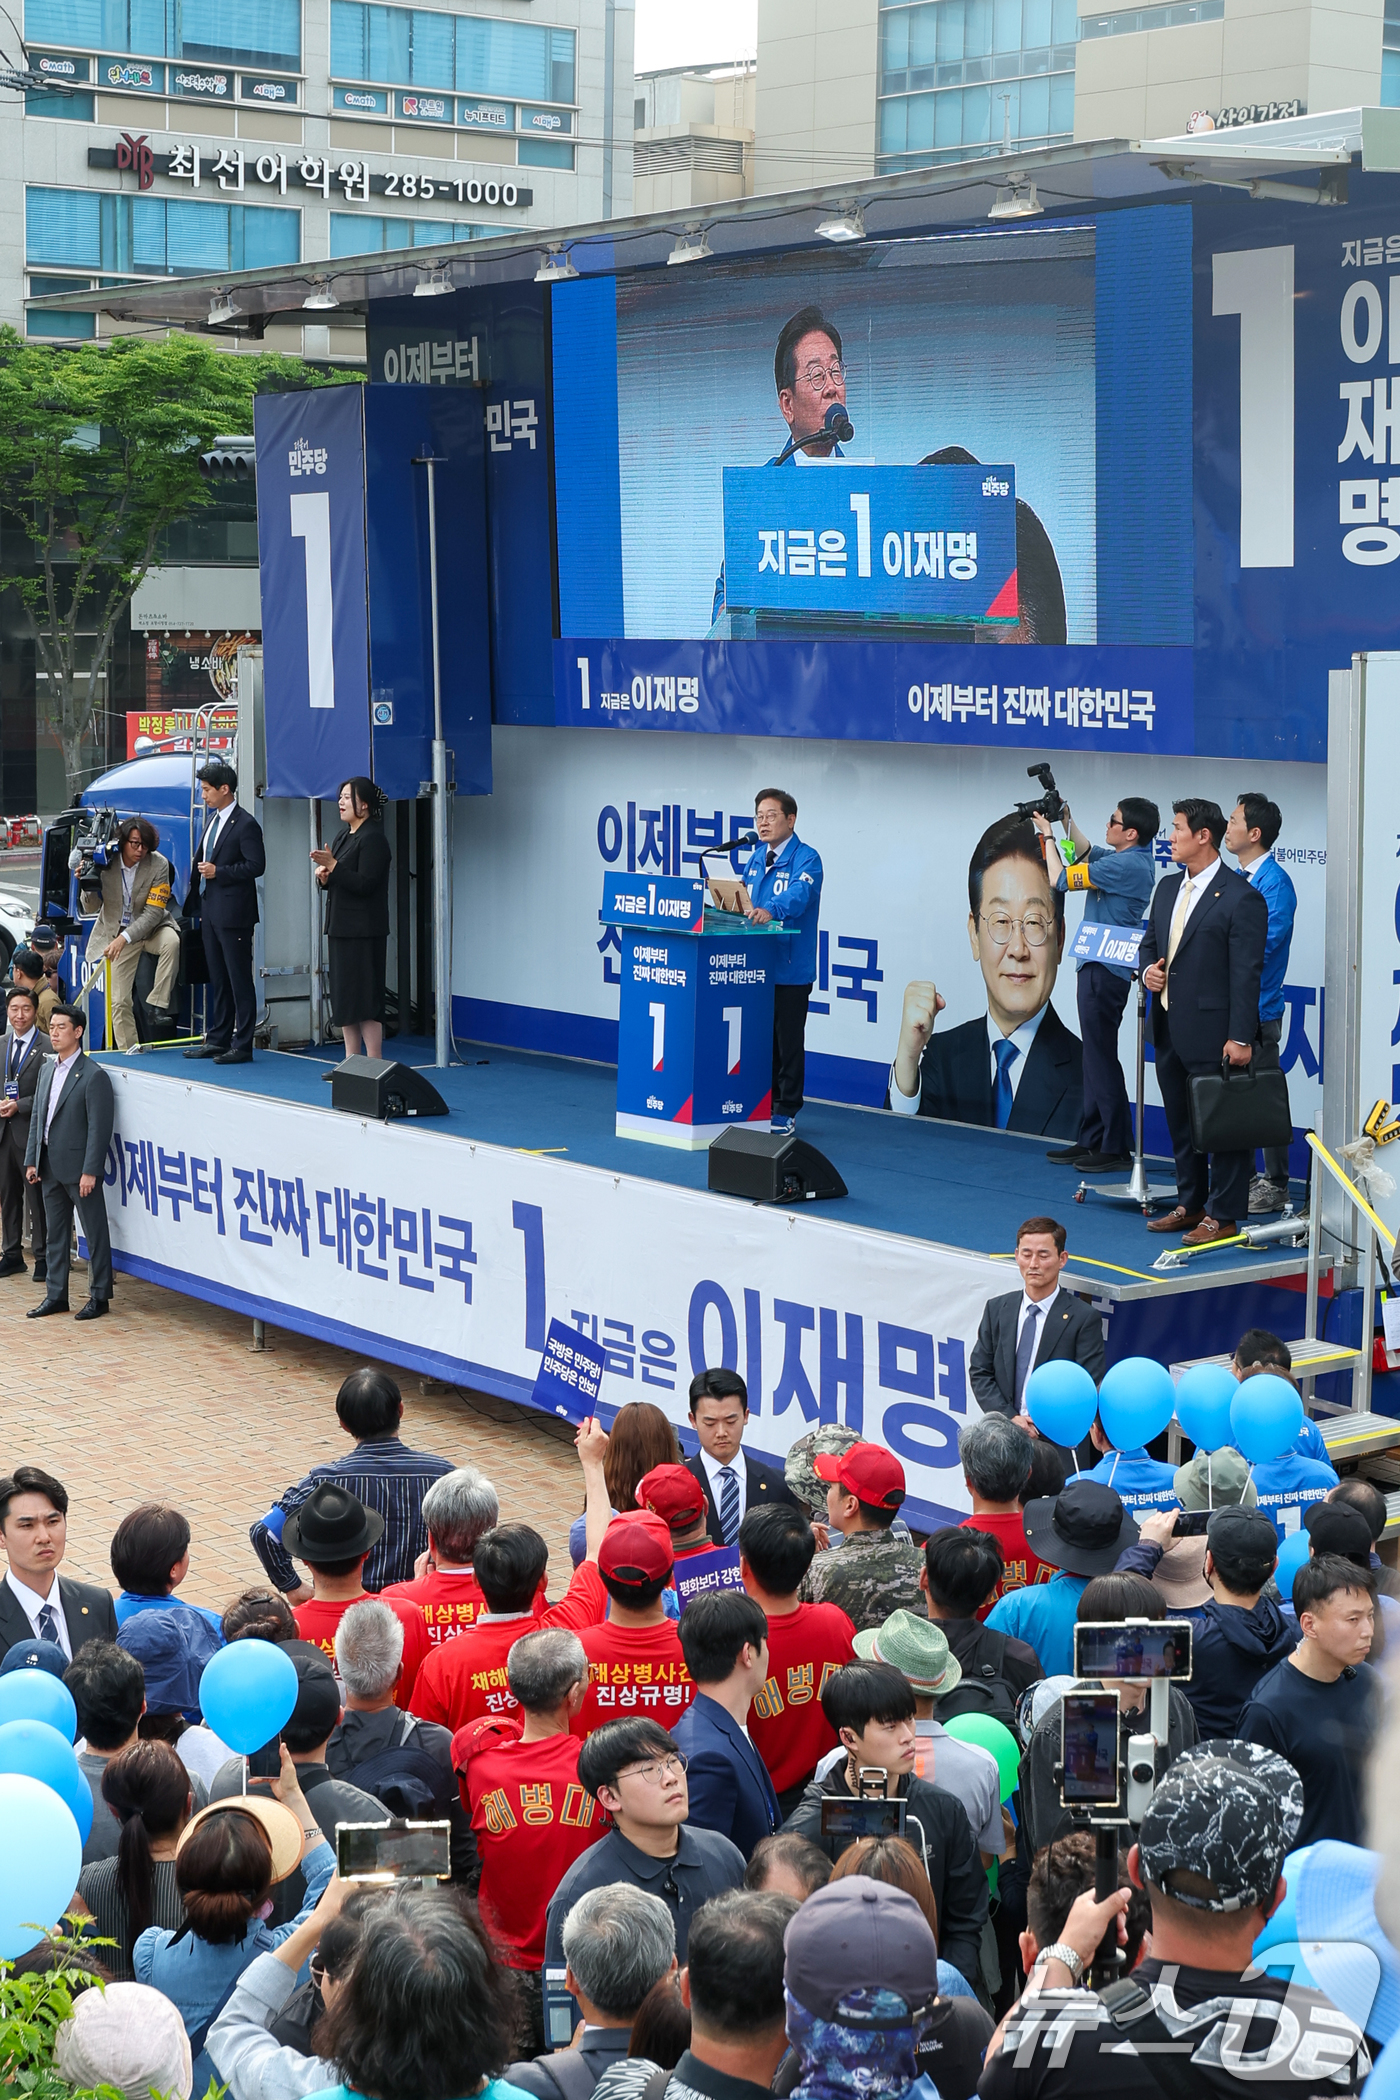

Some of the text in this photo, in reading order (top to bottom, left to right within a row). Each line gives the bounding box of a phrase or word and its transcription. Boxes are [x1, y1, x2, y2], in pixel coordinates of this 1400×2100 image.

[39, 58, 75, 74] Cmath
[345, 93, 376, 107] Cmath
[465, 110, 506, 124] 뉴기프티드
[116, 133, 518, 207] DYB 최선어학원 285-1000
[384, 336, 478, 384] 이제부터
[1212, 244, 1295, 568] 1
[289, 448, 328, 476] 민주당
[982, 481, 1010, 497] 민주당
[757, 493, 978, 581] 지금은 1 이재명
[290, 492, 335, 708] 1
[189, 656, 222, 670] 냉소바
[577, 657, 699, 714] 1 지금은 이재명
[908, 682, 1156, 731] 이제부터 진짜 대한민국
[613, 883, 691, 919] 지금은 1 이재명
[633, 945, 668, 966] 이제부터
[1096, 928, 1112, 957] 1
[1104, 939, 1140, 963] 이재명
[70, 945, 77, 987] 1
[709, 953, 747, 969] 이제부터
[632, 965, 687, 988] 진짜 대한민국
[708, 969, 766, 986] 진짜 대한민국
[648, 1001, 666, 1073] 1
[722, 1006, 743, 1076] 1
[646, 1098, 664, 1111] 민주당
[721, 1103, 743, 1114] 민주당
[103, 1133, 226, 1236] 이제부터
[232, 1166, 310, 1258] 진짜
[315, 1186, 478, 1305] 대한민국
[512, 1199, 546, 1354] 1
[687, 1279, 967, 1469] 이재명
[547, 1337, 601, 1379] 국방은 민주당!
[543, 1355, 598, 1398] 민주당은 안보!
[1138, 1492, 1153, 1505] 진짜
[1284, 1492, 1299, 1505] 진짜
[679, 1571, 720, 1597] 평화보다
[596, 1684, 690, 1707] 진상규명!
[480, 1782, 596, 1834] 해병대
